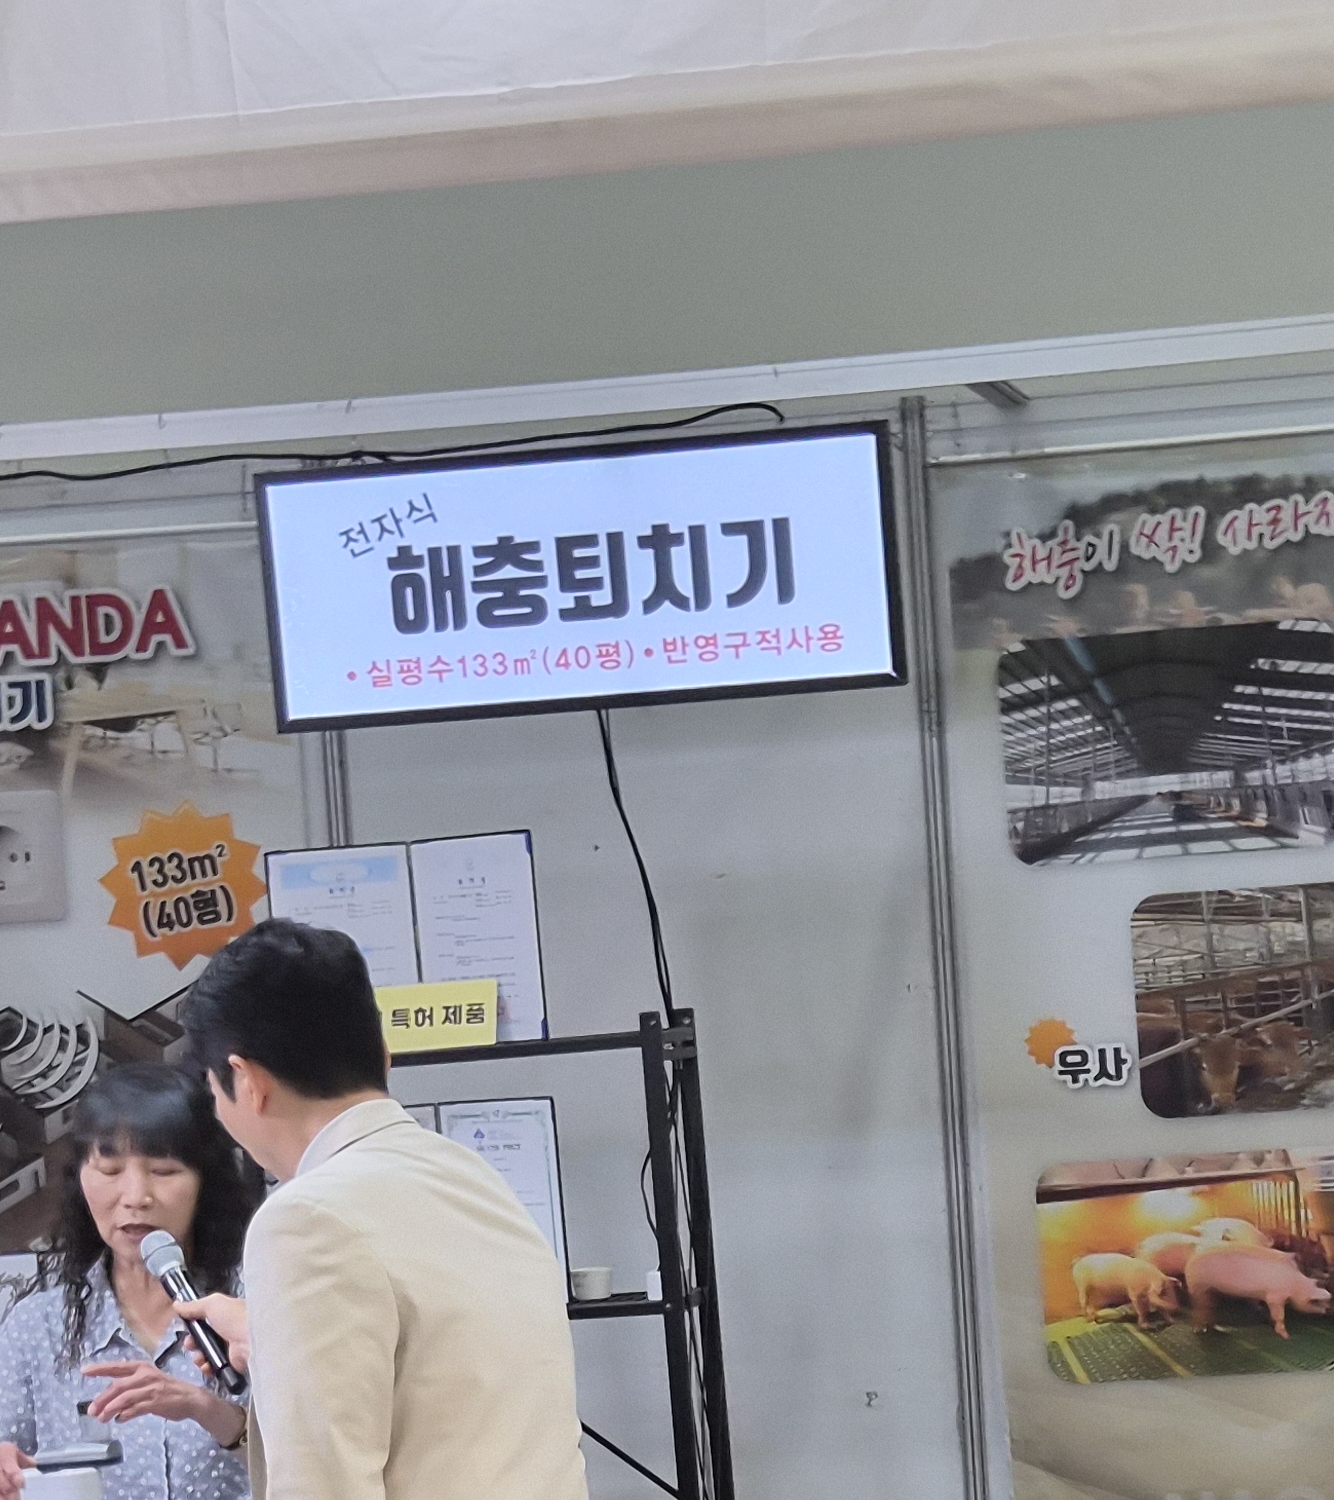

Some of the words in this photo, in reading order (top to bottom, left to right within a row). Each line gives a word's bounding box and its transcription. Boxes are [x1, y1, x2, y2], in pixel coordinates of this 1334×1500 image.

[339, 492, 440, 559] 전자식
[1013, 531, 1115, 592] 해충이
[1136, 512, 1199, 565] 싹!
[387, 515, 796, 635] 해충퇴치기
[662, 623, 845, 664] 반영구적사용
[391, 1008, 434, 1028] 특허
[441, 1003, 485, 1025] 제품
[1058, 1048, 1128, 1084] 우사
